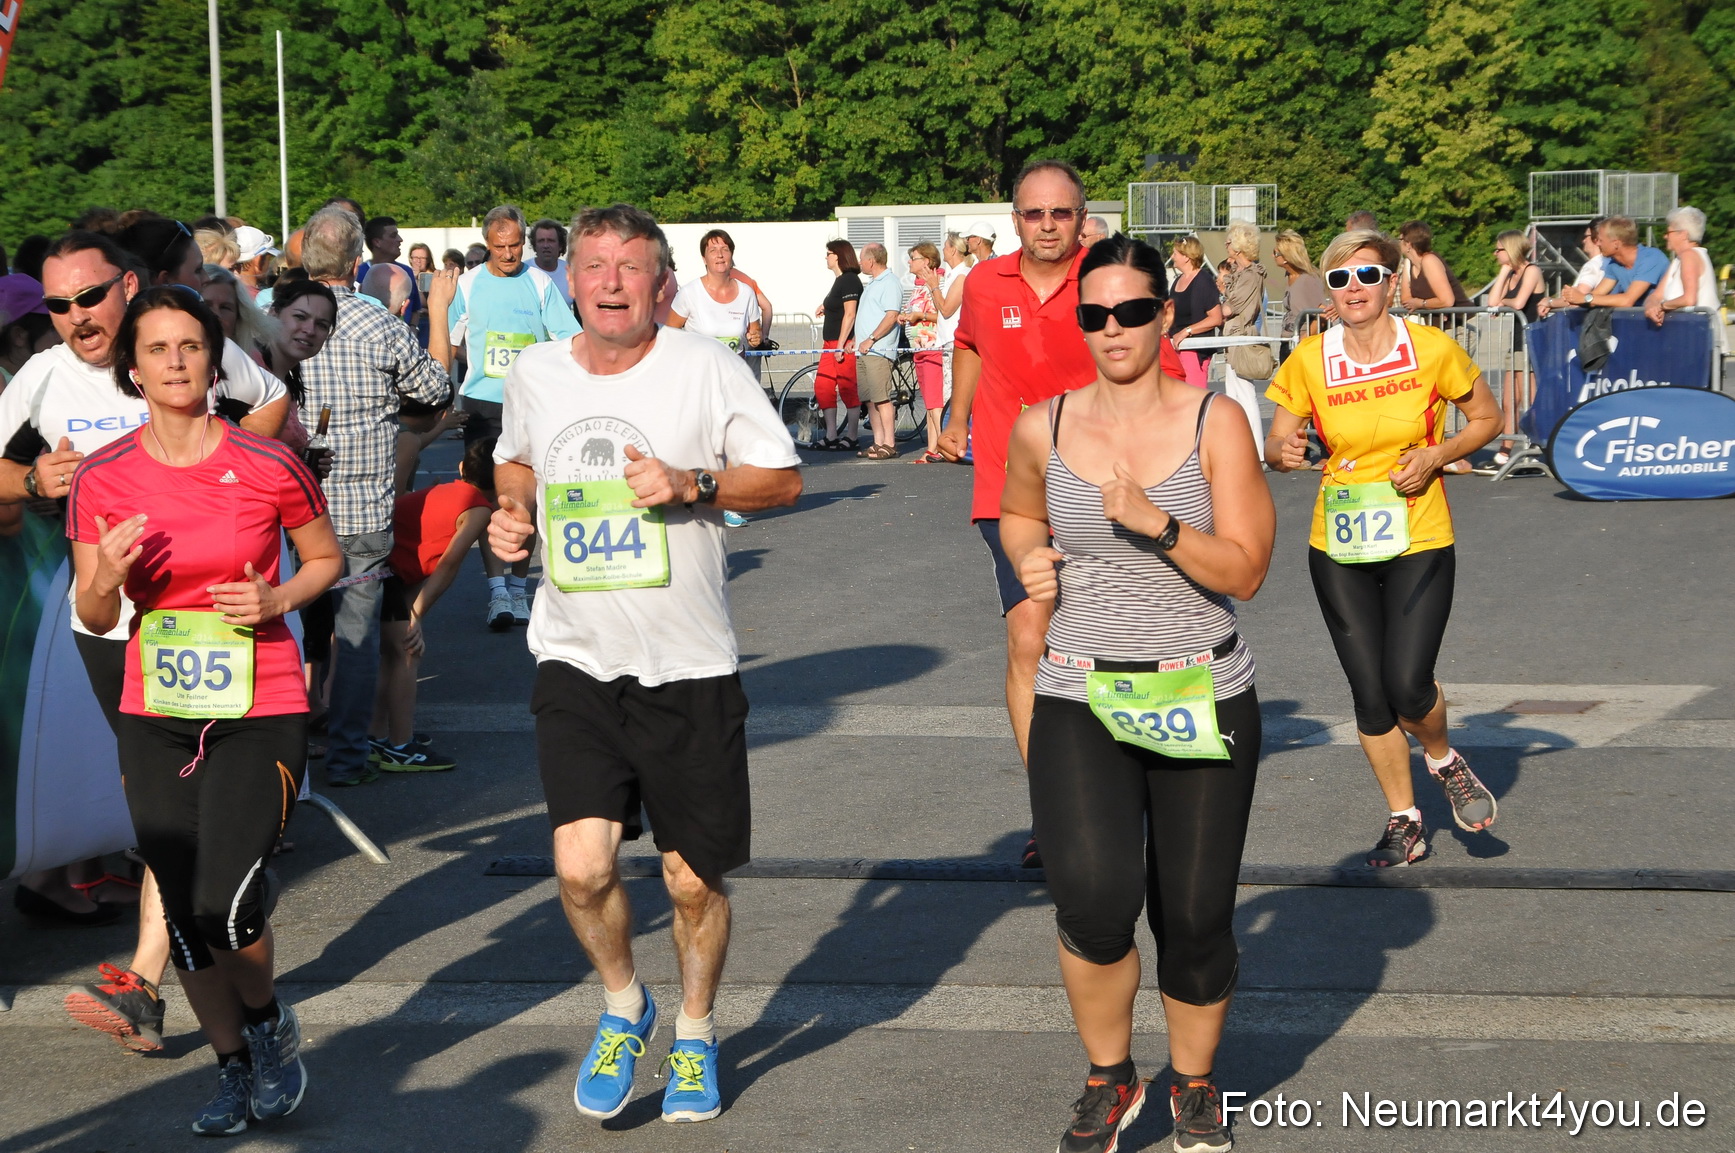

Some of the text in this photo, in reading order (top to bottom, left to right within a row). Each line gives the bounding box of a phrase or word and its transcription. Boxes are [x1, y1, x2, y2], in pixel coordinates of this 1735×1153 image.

[1327, 376, 1423, 407] MAX BÖGL
[1577, 369, 1671, 403] Fisch
[547, 420, 602, 477] CHIANGDAO
[1604, 436, 1735, 464] Fischer
[1617, 461, 1729, 477] AUTOMOBILE
[561, 499, 599, 510] firmenlauf
[1334, 510, 1394, 544] 812
[563, 517, 647, 564] 844
[586, 565, 605, 573] Stefan
[155, 628, 191, 638] firmenlauf
[156, 648, 232, 692] 595
[1049, 651, 1092, 669] POWER MAN
[1159, 652, 1211, 672] POWER MAN
[153, 698, 171, 706] Kliniken
[1107, 691, 1150, 700] firmenlauf
[1110, 707, 1198, 742] 839
